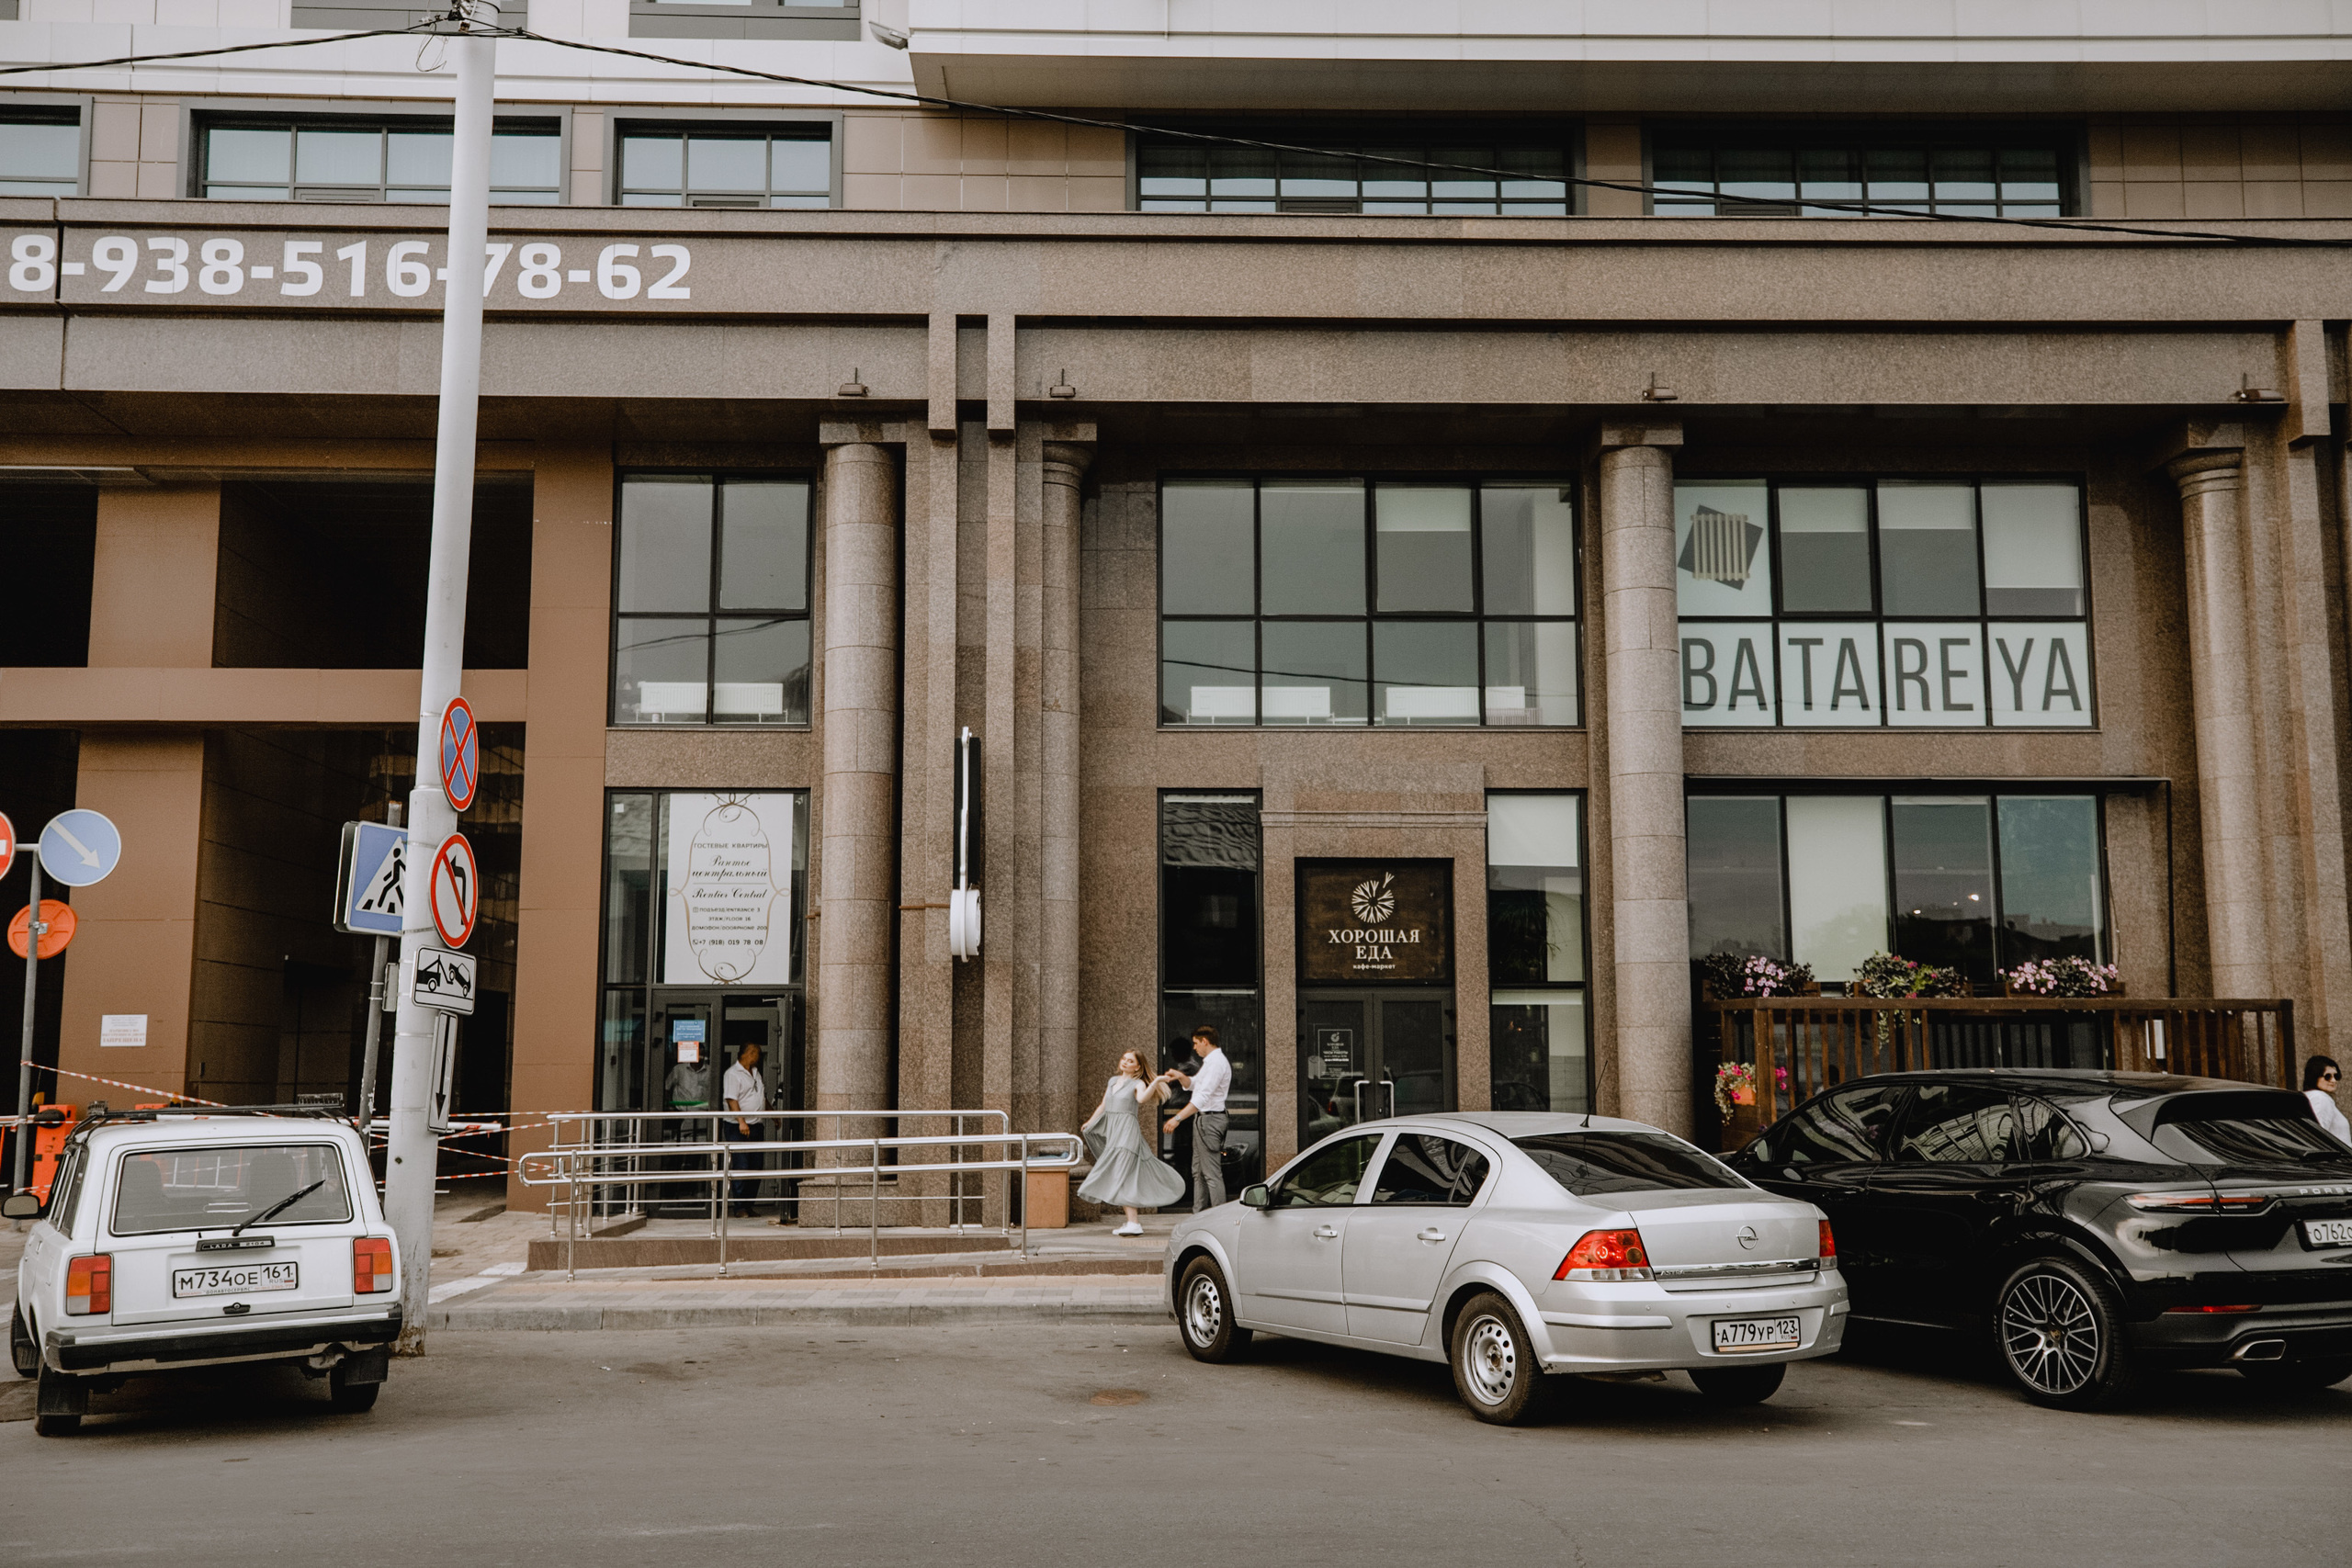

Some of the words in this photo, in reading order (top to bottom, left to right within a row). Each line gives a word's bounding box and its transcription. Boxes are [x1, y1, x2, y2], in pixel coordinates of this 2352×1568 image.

[1681, 637, 2082, 712] BATAREYA
[710, 855, 750, 866] Рантье
[692, 888, 728, 898] Rentier
[731, 888, 768, 898] Central
[1328, 929, 1420, 943] ХОРОШАЯ
[1355, 945, 1393, 962] ЕДА
[180, 1270, 258, 1290] М734ОЕ
[263, 1266, 291, 1279] 161
[1721, 1324, 1774, 1343] А779УР
[1777, 1320, 1795, 1335] 123
